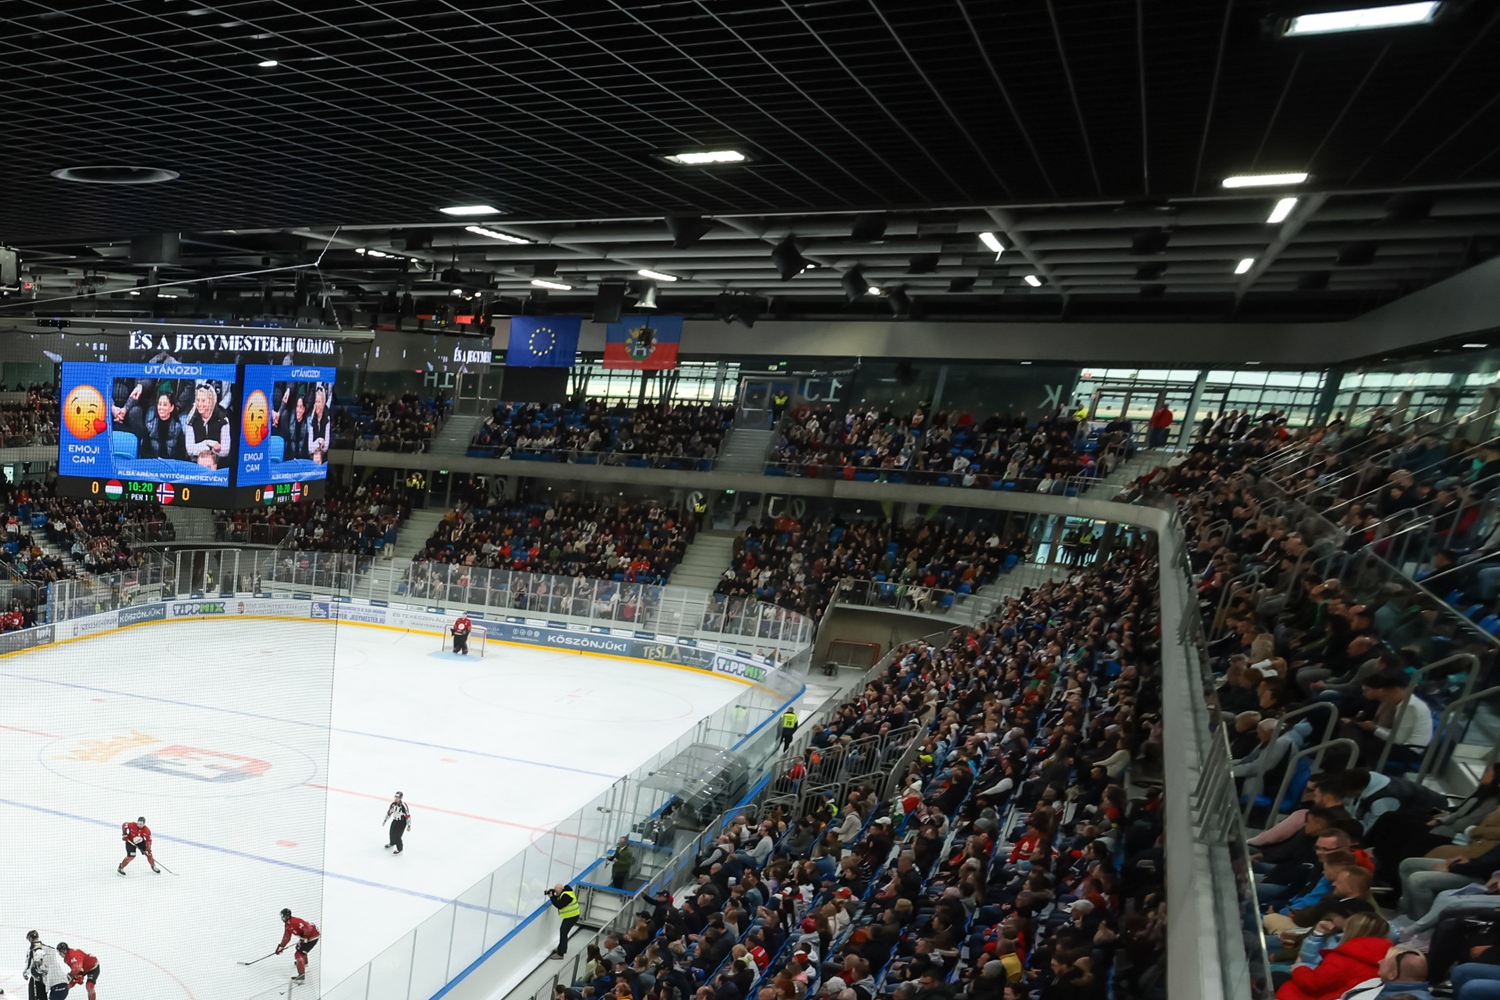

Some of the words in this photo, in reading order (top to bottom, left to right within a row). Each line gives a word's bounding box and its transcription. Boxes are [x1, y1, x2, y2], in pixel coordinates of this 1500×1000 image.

[129, 331, 153, 350] ÉS
[157, 335, 169, 350] A
[174, 334, 295, 353] JEGYMESTER.HU
[144, 364, 202, 375] UTÁNOZD!
[68, 444, 100, 454] EMOJI
[72, 455, 96, 464] CAM
[245, 464, 260, 472] CAM
[128, 481, 153, 493] 10:20
[547, 634, 627, 652] KÖSZÖNJÜK!
[643, 644, 682, 660] TESLA
